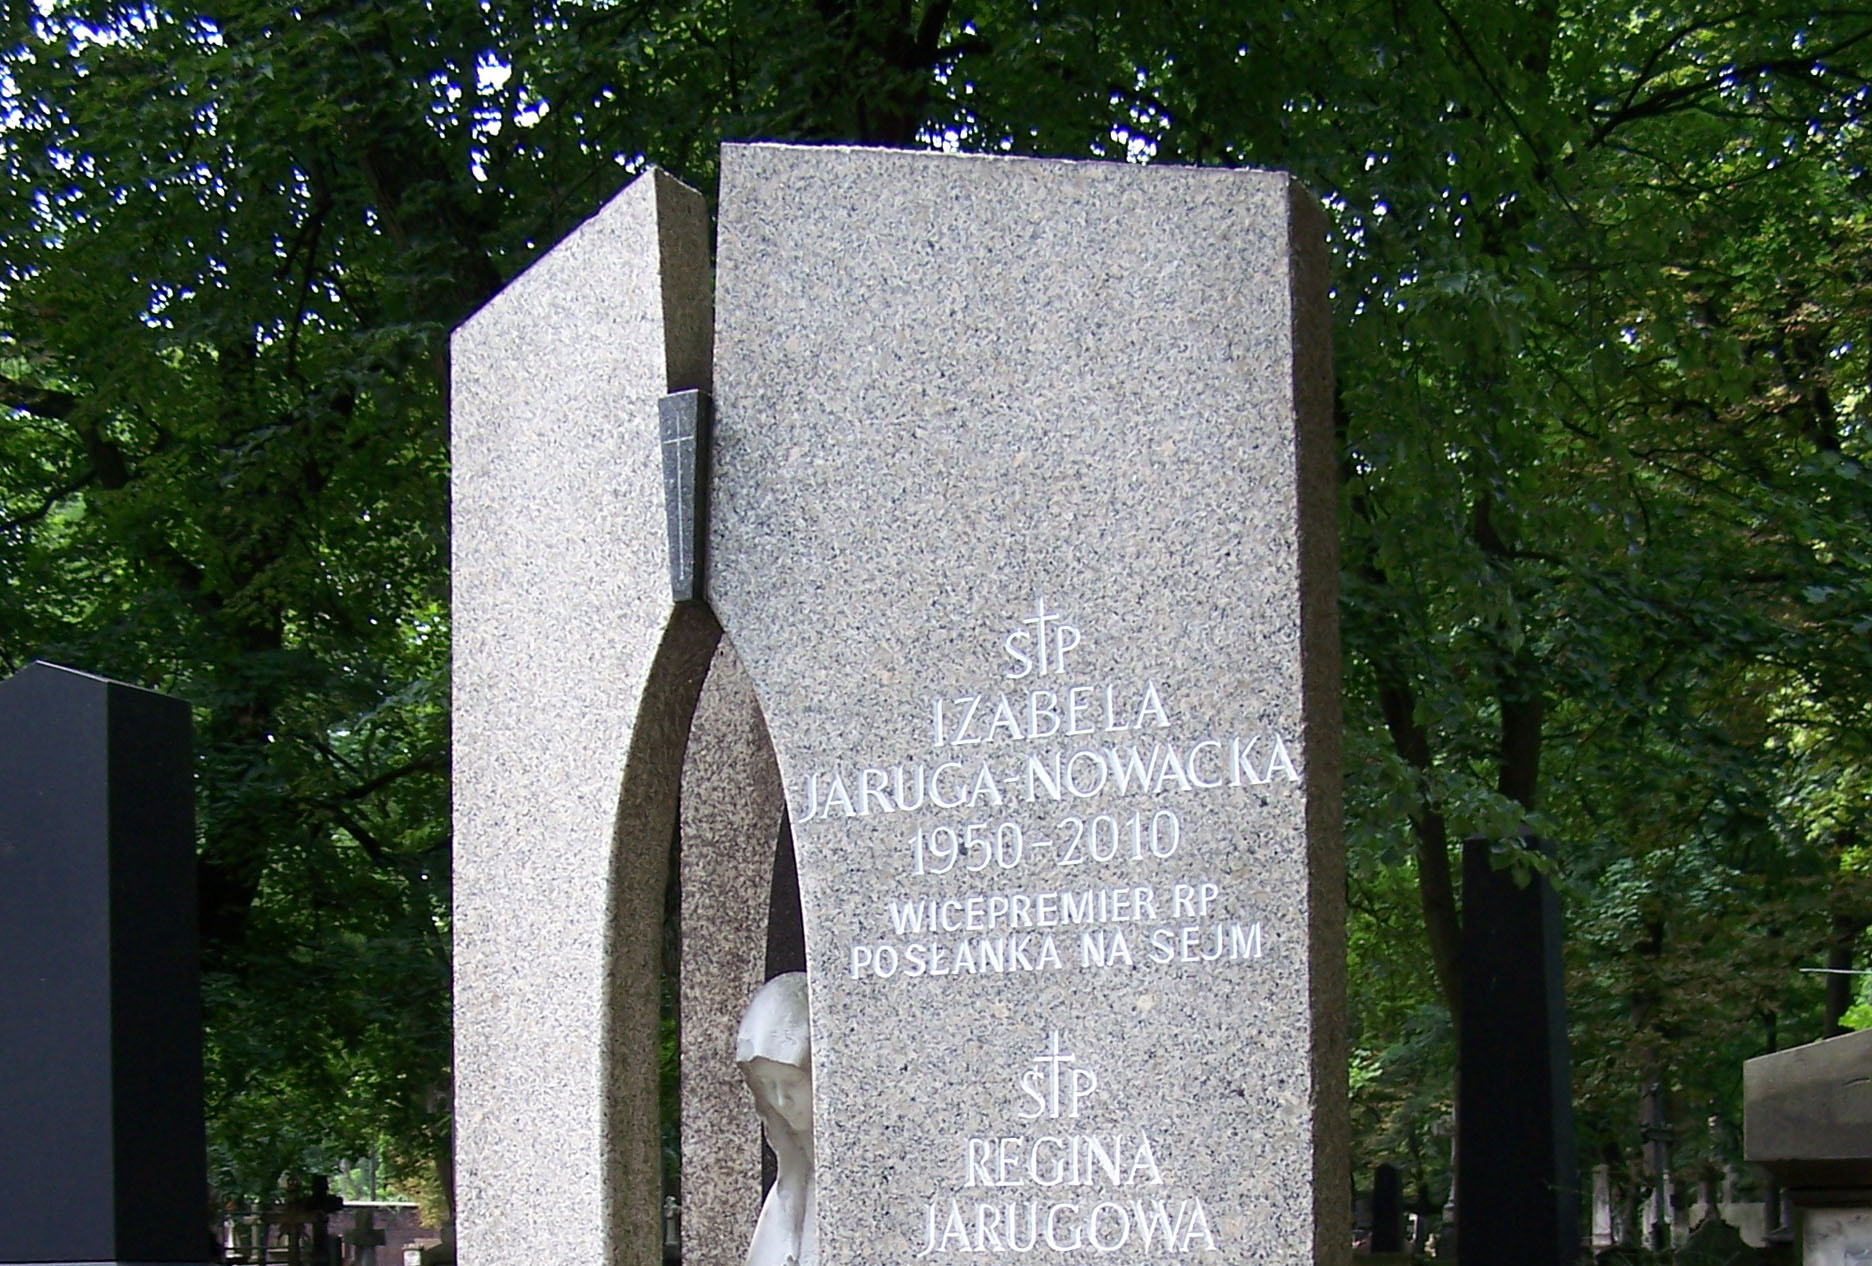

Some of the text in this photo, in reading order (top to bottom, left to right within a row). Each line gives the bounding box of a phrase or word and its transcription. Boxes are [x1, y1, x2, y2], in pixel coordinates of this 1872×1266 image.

[934, 680, 1170, 748] IZABELA
[798, 733, 1301, 823] JARUGA-NOWACKA
[908, 810, 1180, 876] 1950-2010
[889, 882, 1220, 935] WICEPREMIER RP
[851, 921, 1263, 980] POSŁANKA NA SEJM
[963, 1131, 1163, 1188] REGINA
[917, 1197, 1218, 1258] JARUGOWA
